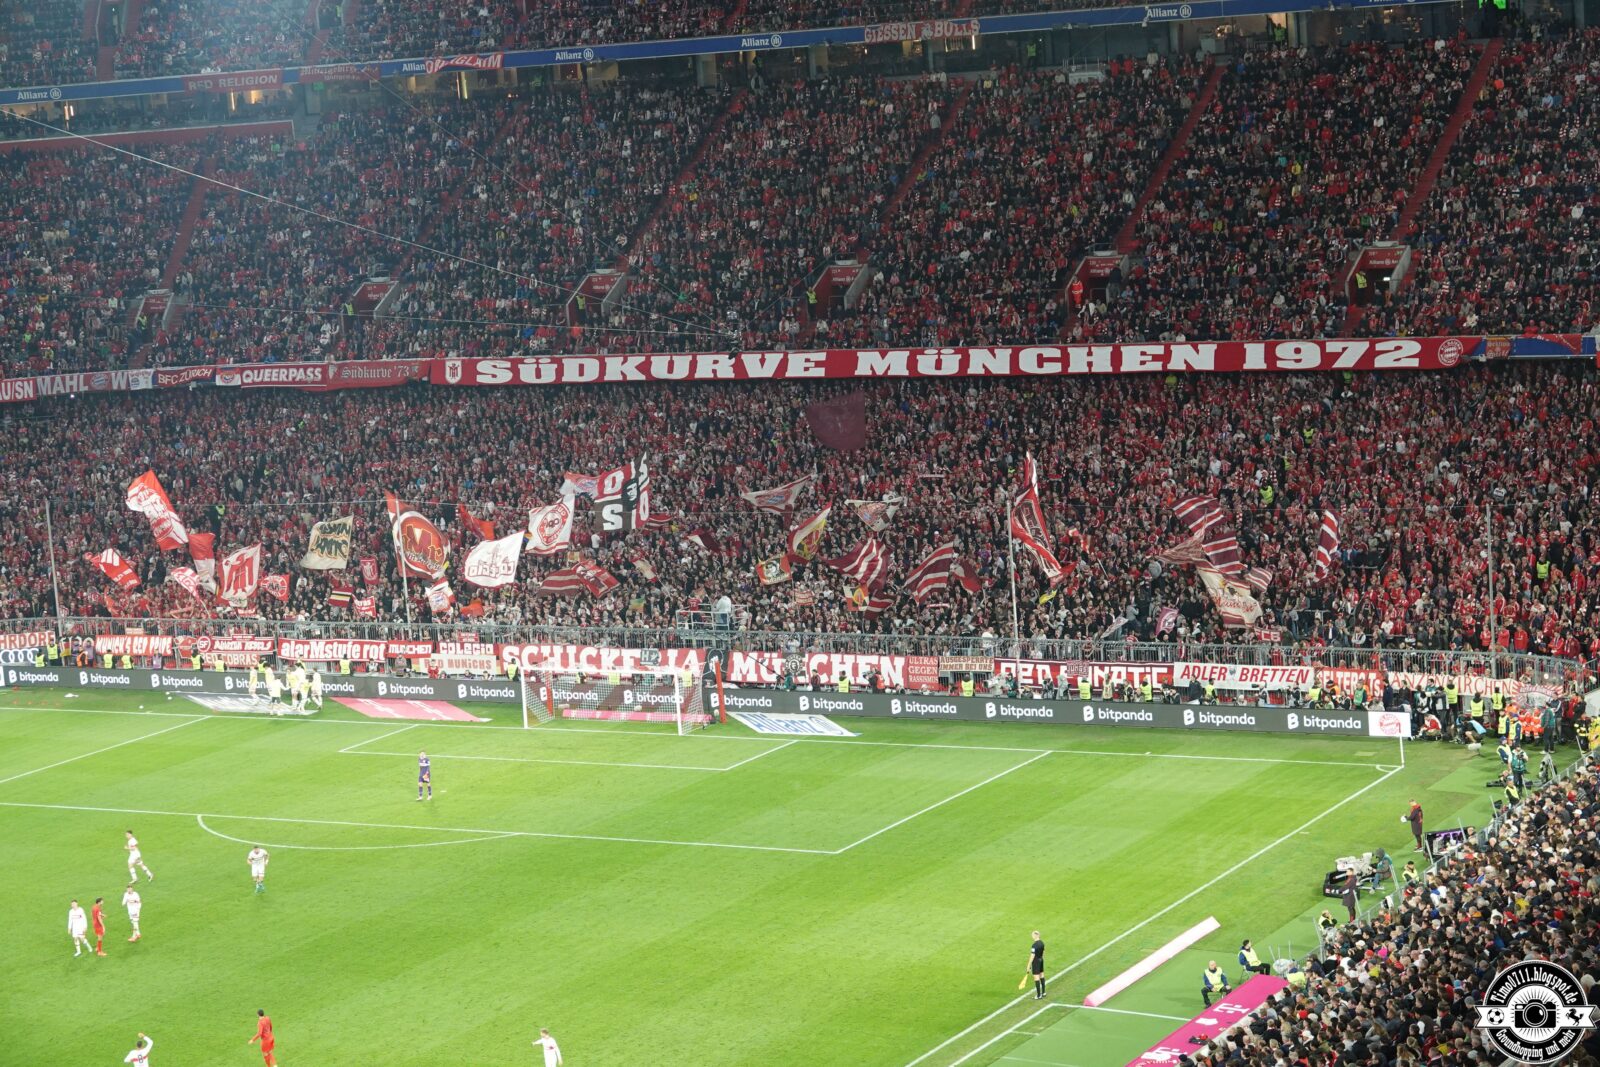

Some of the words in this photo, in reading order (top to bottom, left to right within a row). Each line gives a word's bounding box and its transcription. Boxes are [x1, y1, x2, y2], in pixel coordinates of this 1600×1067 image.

[1146, 6, 1179, 18] Allianz
[864, 23, 917, 43] GIESSEN
[933, 18, 980, 37] BULLS
[741, 37, 770, 48] Allianz
[555, 50, 583, 61] Allianz
[402, 62, 426, 73] Allian
[218, 73, 278, 88] RELIGION
[17, 89, 49, 100] Allianz
[476, 351, 827, 384] SÜDKURVE
[854, 343, 1218, 376] MÜNCHEN
[1242, 340, 1422, 370] 1972
[157, 373, 179, 385] BFC
[241, 367, 322, 384] QUEERPASS
[340, 367, 393, 380] Südkurve
[362, 644, 386, 660] rot
[222, 653, 258, 666] COBRAS
[908, 656, 938, 665] ULTRAS
[19, 671, 60, 683] bitpanda
[908, 666, 938, 675] GEGEN
[1181, 664, 1228, 681] ADLER
[1238, 666, 1310, 684] BRETTEN
[90, 673, 130, 687] bitpanda
[162, 675, 203, 688] bitpanda
[908, 675, 939, 683] RASSISMUS
[390, 683, 434, 696] bitpanda
[470, 685, 515, 699] bitpanda
[552, 688, 599, 702] bitpanda
[637, 691, 684, 706] bitpanda
[724, 693, 772, 708] bitpanda
[813, 697, 864, 712] bitpanda
[905, 701, 957, 716] bitpanda
[1000, 704, 1054, 719] bitpanda
[1098, 708, 1153, 723] bitpanda
[1199, 711, 1256, 726] bitpanda
[1303, 714, 1362, 730] bitpanda
